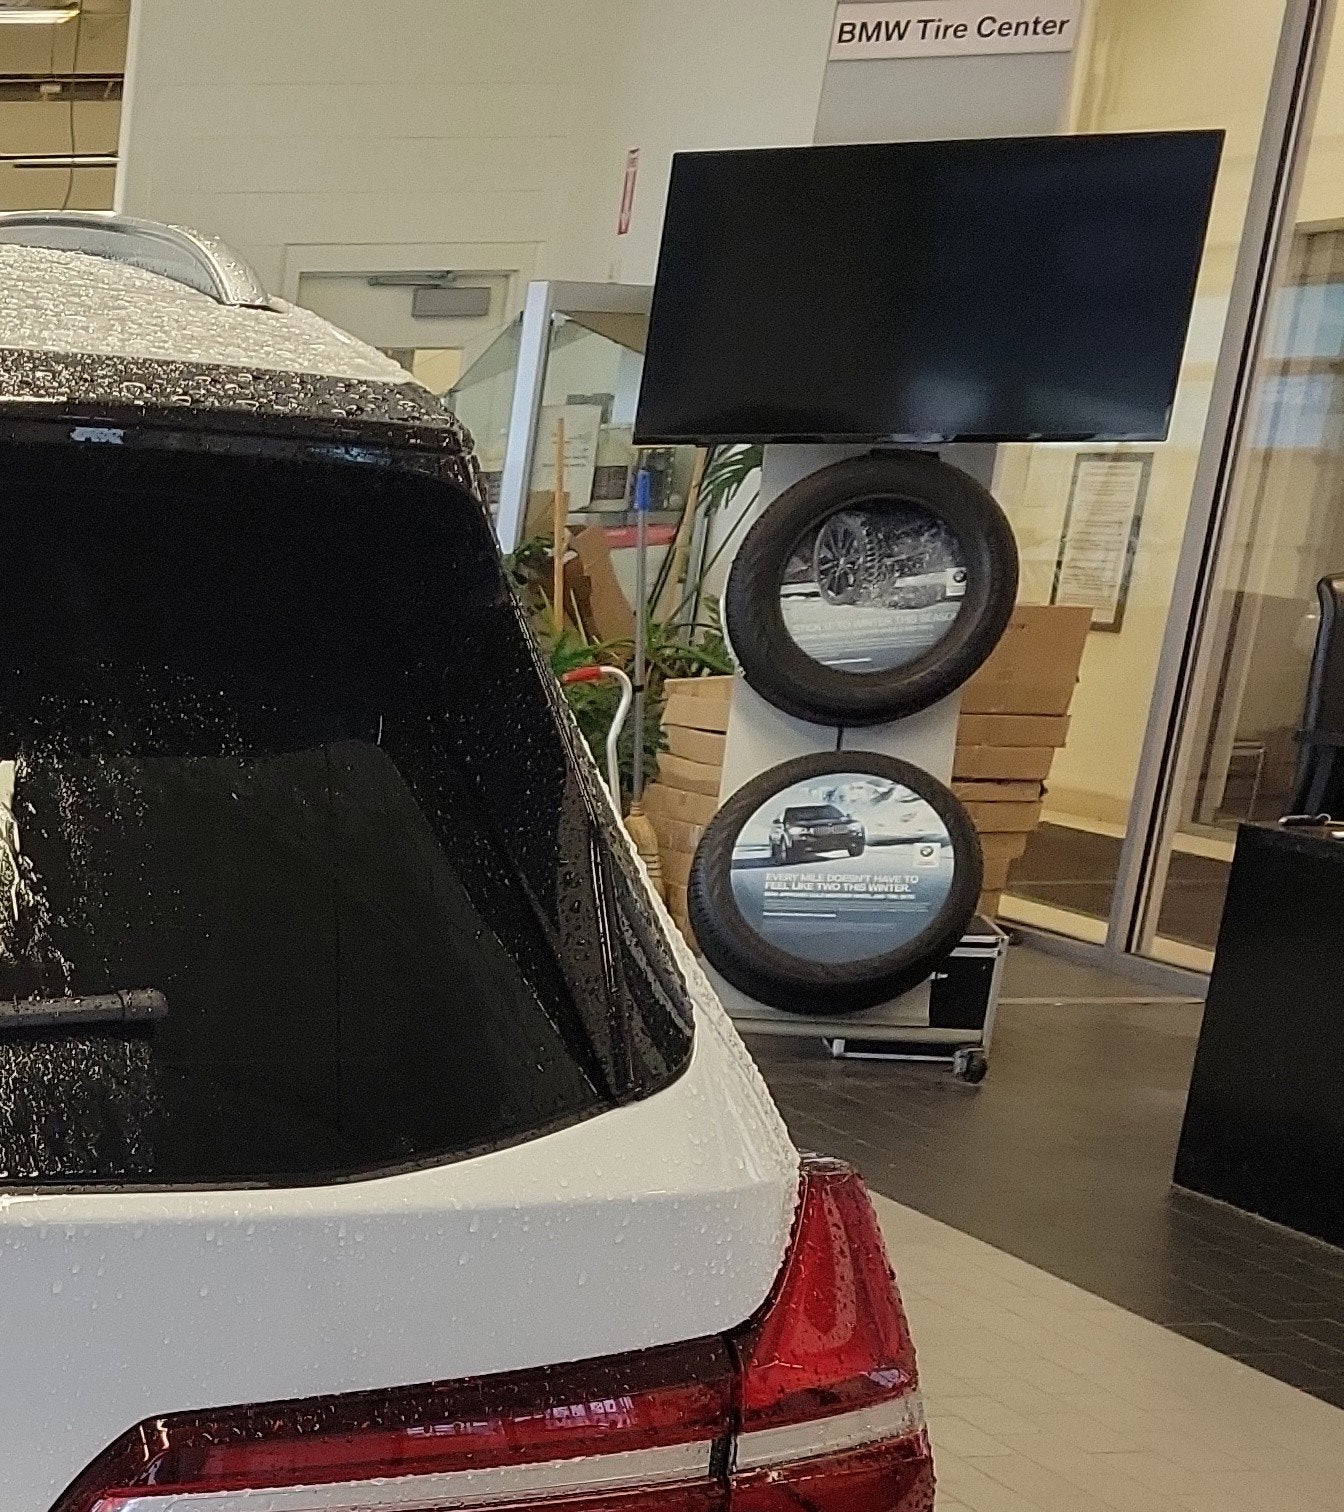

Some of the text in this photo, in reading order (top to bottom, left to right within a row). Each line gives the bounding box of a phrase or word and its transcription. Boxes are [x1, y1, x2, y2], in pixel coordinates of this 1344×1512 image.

[837, 15, 1071, 44] BMW Tire Center
[765, 873, 799, 882] EVERY
[800, 873, 825, 882] MILE
[873, 874, 902, 884] HAVE
[904, 875, 919, 884] TO
[765, 882, 791, 890] FEEL
[791, 882, 814, 891] LIKE
[817, 882, 841, 891] TWO
[843, 883, 867, 892] THIS
